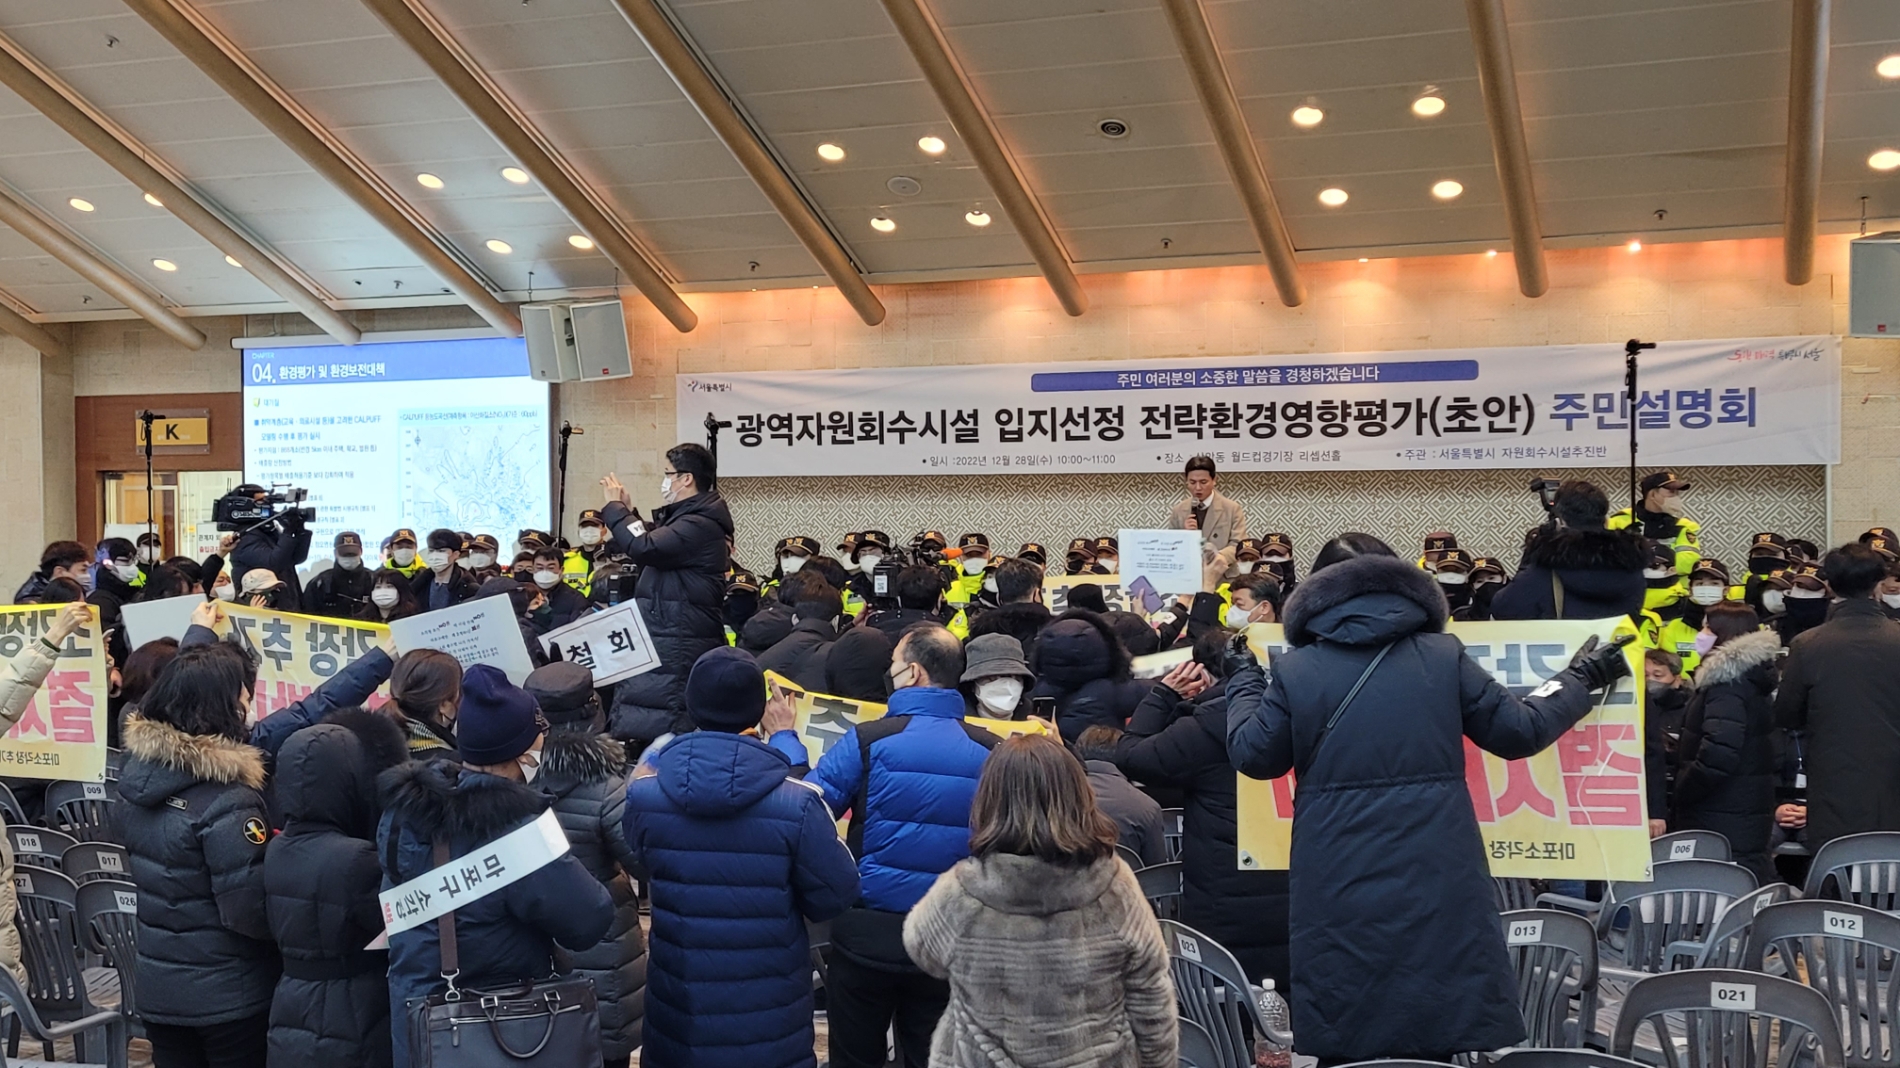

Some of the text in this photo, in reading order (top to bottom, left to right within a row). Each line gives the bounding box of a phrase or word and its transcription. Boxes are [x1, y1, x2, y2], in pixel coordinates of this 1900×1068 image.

[252, 362, 386, 383] 04. 환경평가 및 환경보전대책
[1117, 366, 1380, 388] 주민 여러분의 소중한 말씀을 경청하겠습니다
[699, 382, 732, 392] 서울특별시
[735, 387, 1756, 447] 광역자원회수시설 입지선정 전략환경영향평가(초안) 주민설명회
[165, 424, 180, 440] K
[1164, 452, 1184, 464] 장소
[1231, 450, 1294, 463] 월드컵경기장
[1299, 450, 1341, 462] 리셉션홀
[1404, 448, 1426, 460] 주관
[1501, 445, 1607, 459] 자원회수시설추진반
[930, 456, 948, 467] 일시
[991, 455, 1011, 466] 12월
[1015, 453, 1053, 466] 28일(수)
[1057, 454, 1116, 465] 10:00~11:00
[566, 627, 636, 669] 철회
[86, 786, 102, 794] 009
[20, 837, 37, 847] 018
[1674, 844, 1691, 853] 006
[101, 856, 117, 866] 017
[14, 878, 27, 887] 27
[439, 854, 506, 899] 마포구
[119, 895, 136, 906] 026
[1829, 916, 1856, 930] 012
[1514, 926, 1537, 937] 013
[1180, 938, 1196, 954] 023
[1718, 988, 1747, 1001] 021
